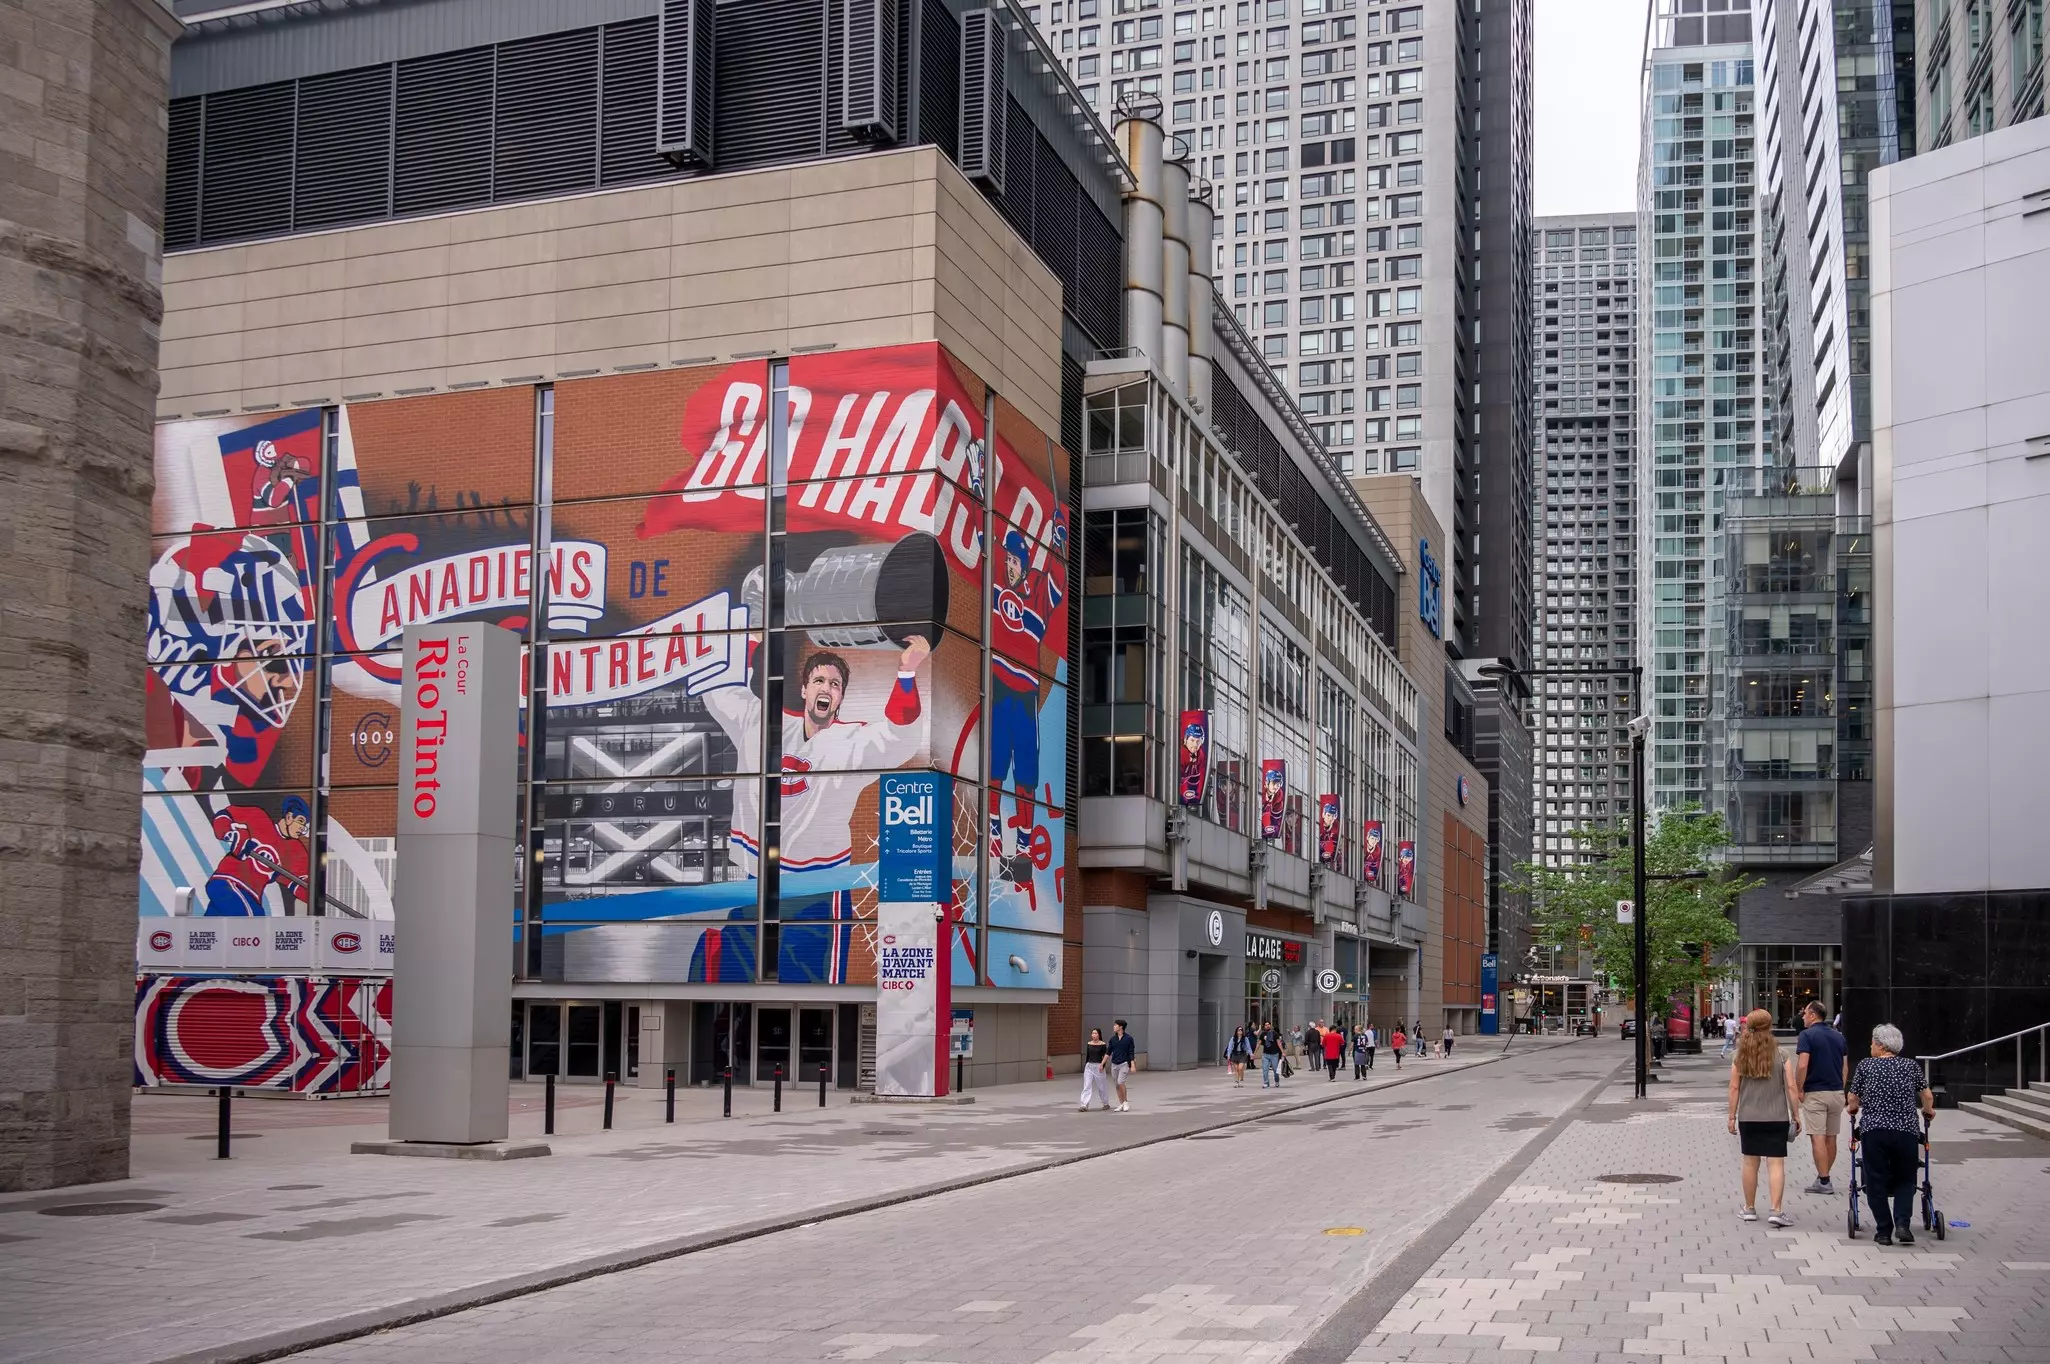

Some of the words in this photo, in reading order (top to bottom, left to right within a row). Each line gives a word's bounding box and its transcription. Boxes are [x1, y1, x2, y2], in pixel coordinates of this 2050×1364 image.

[683, 381, 812, 502] GO
[630, 559, 670, 599] DE
[457, 636, 470, 654] La
[456, 660, 469, 696] Cour
[350, 730, 394, 745] 1909
[885, 778, 933, 795] Centre
[572, 795, 710, 814] FORUM
[885, 795, 933, 825] Bell
[232, 937, 252, 946] CIBC
[1246, 935, 1257, 957] LA
[1259, 938, 1282, 960] CAGE
[883, 948, 899, 958] LA
[902, 948, 933, 958] ZONE
[1482, 959, 1496, 968] Bell
[882, 968, 926, 978] MATCH
[882, 981, 905, 990] CIBC
